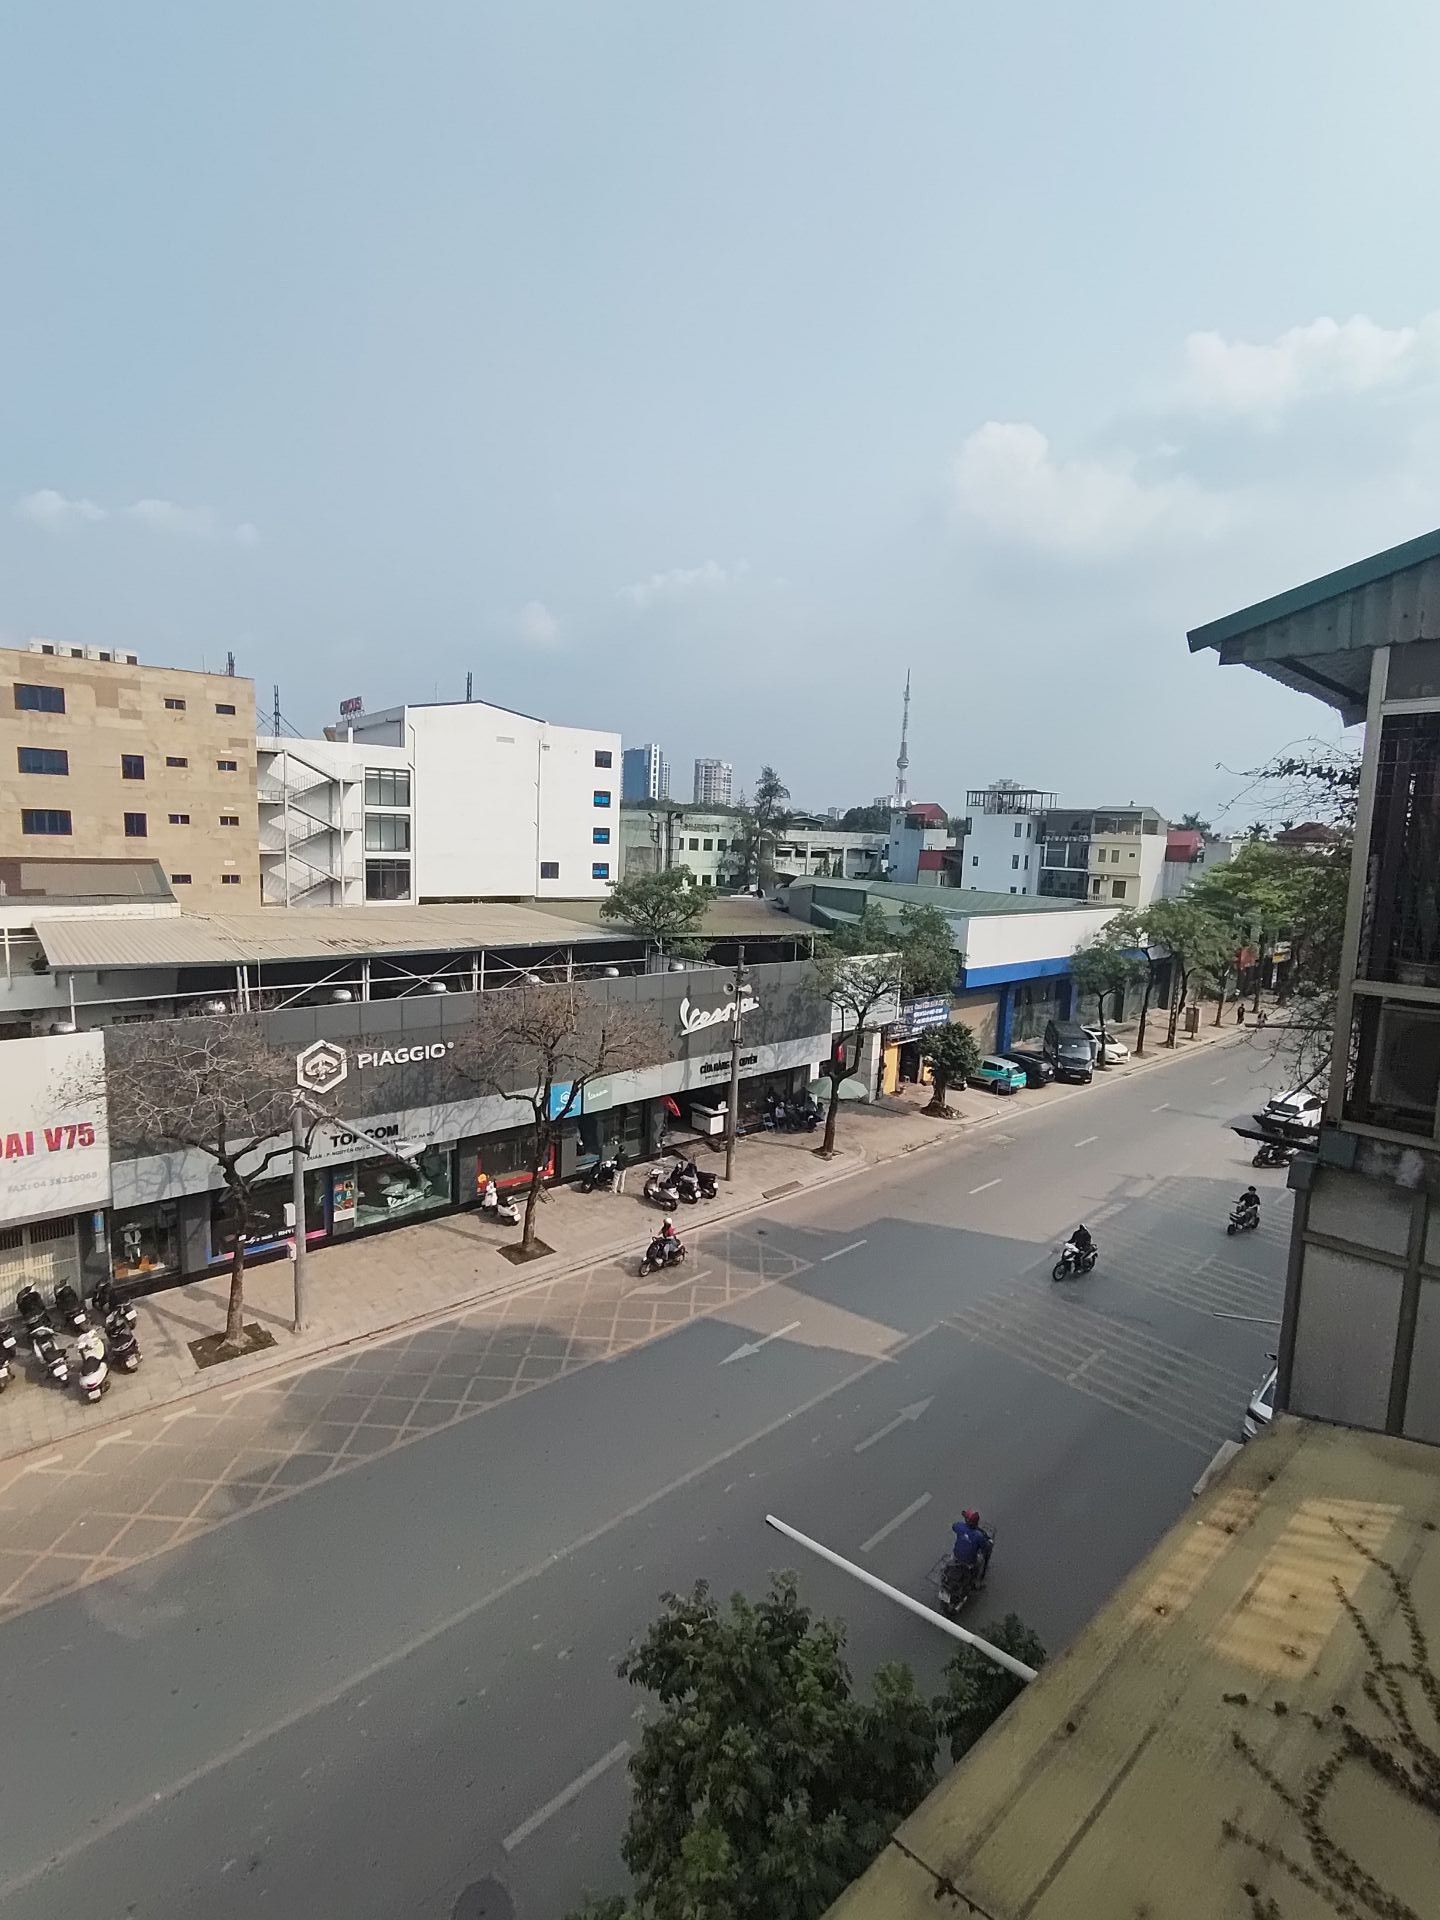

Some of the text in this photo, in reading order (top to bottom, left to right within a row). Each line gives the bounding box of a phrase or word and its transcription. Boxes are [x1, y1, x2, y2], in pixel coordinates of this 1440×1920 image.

[680, 997, 760, 1036] Vespa
[357, 1043, 446, 1069] PIAGGIO
[0, 1121, 95, 1159] AI V75
